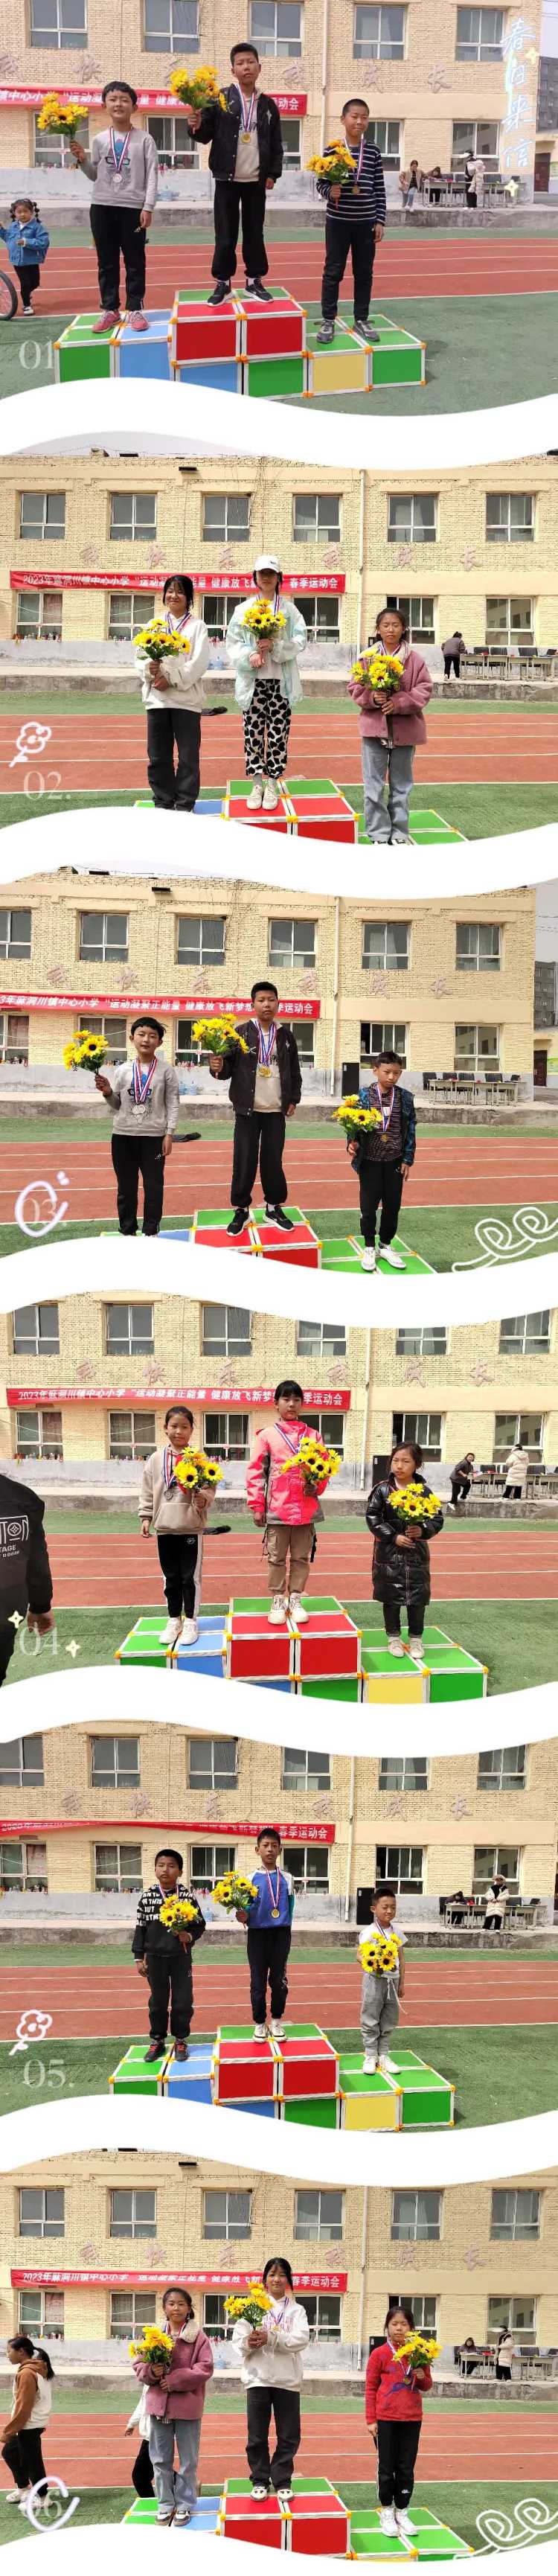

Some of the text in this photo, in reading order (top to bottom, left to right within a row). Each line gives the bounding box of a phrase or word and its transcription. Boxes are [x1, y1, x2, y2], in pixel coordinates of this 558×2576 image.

[0, 90, 43, 102] 镇中心小
[289, 578, 339, 589] 春季运动会
[278, 1002, 313, 1015] 季运动会
[211, 1390, 275, 1403] 健康放飞新梦
[304, 1393, 343, 1405] 季运动会
[278, 1825, 328, 1840] 春季运动会
